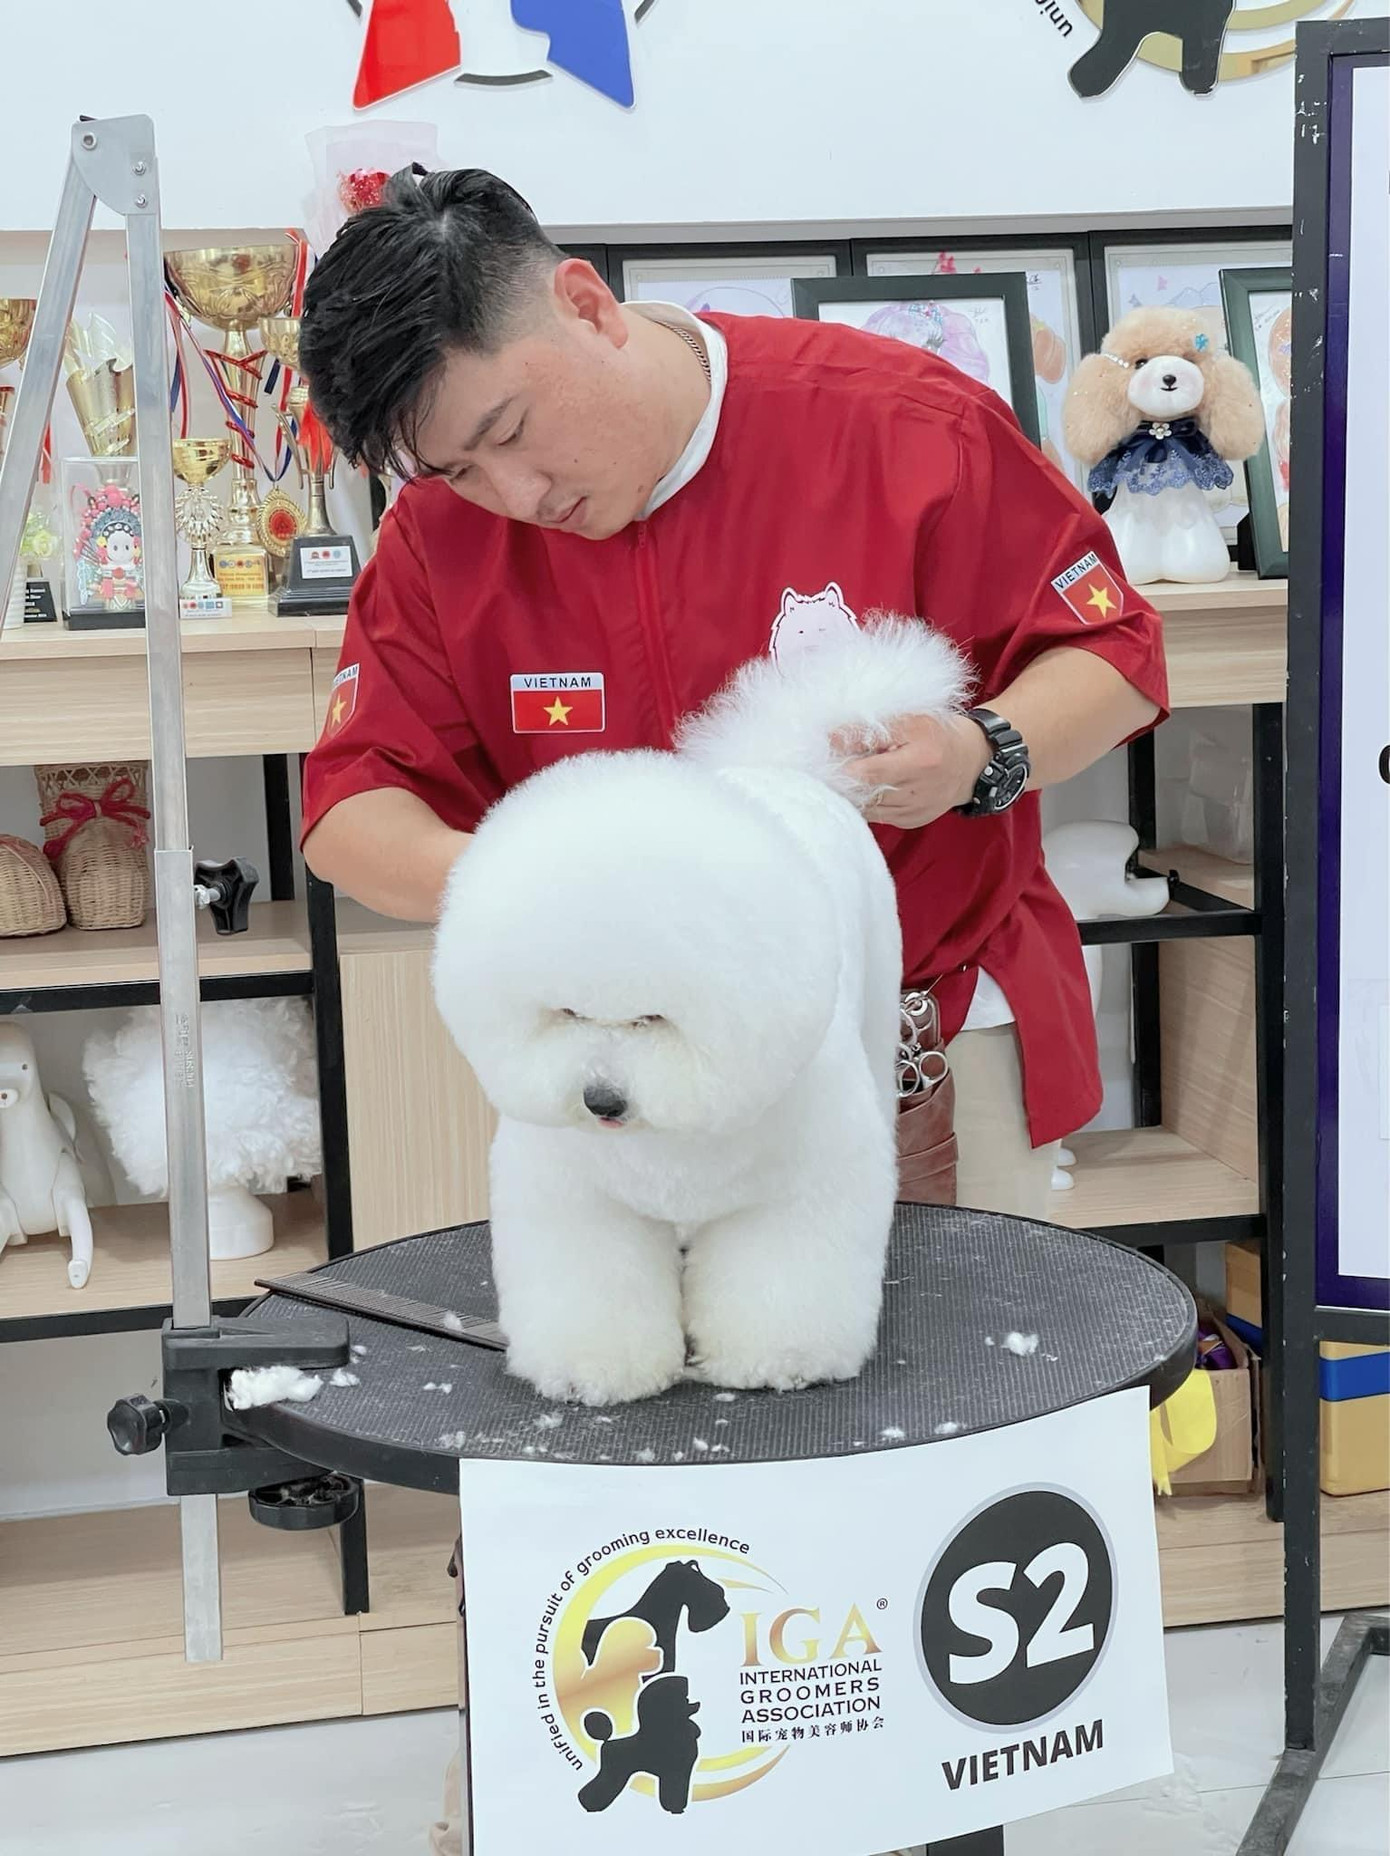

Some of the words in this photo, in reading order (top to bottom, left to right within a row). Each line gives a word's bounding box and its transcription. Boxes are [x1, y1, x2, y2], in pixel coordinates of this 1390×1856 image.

[1055, 553, 1097, 589] VIETNAM
[524, 677, 591, 688] VIETNAM
[577, 1531, 650, 1576] grooming
[655, 1527, 750, 1554] excellence
[560, 1570, 575, 1591] of
[536, 1593, 563, 1654] pursuit
[948, 1542, 1095, 1685] S2
[740, 1603, 882, 1667] IGA
[532, 1660, 546, 1688] the
[740, 1659, 882, 1685] INTERNATIONAL
[538, 1693, 550, 1709] in
[740, 1677, 880, 1704] GROOMERS
[741, 1696, 880, 1723] ASSOCIATION
[541, 1714, 583, 1771] unified
[741, 1716, 884, 1743] 国际宠物美容师协会
[942, 1719, 1104, 1791] VIETNAM
